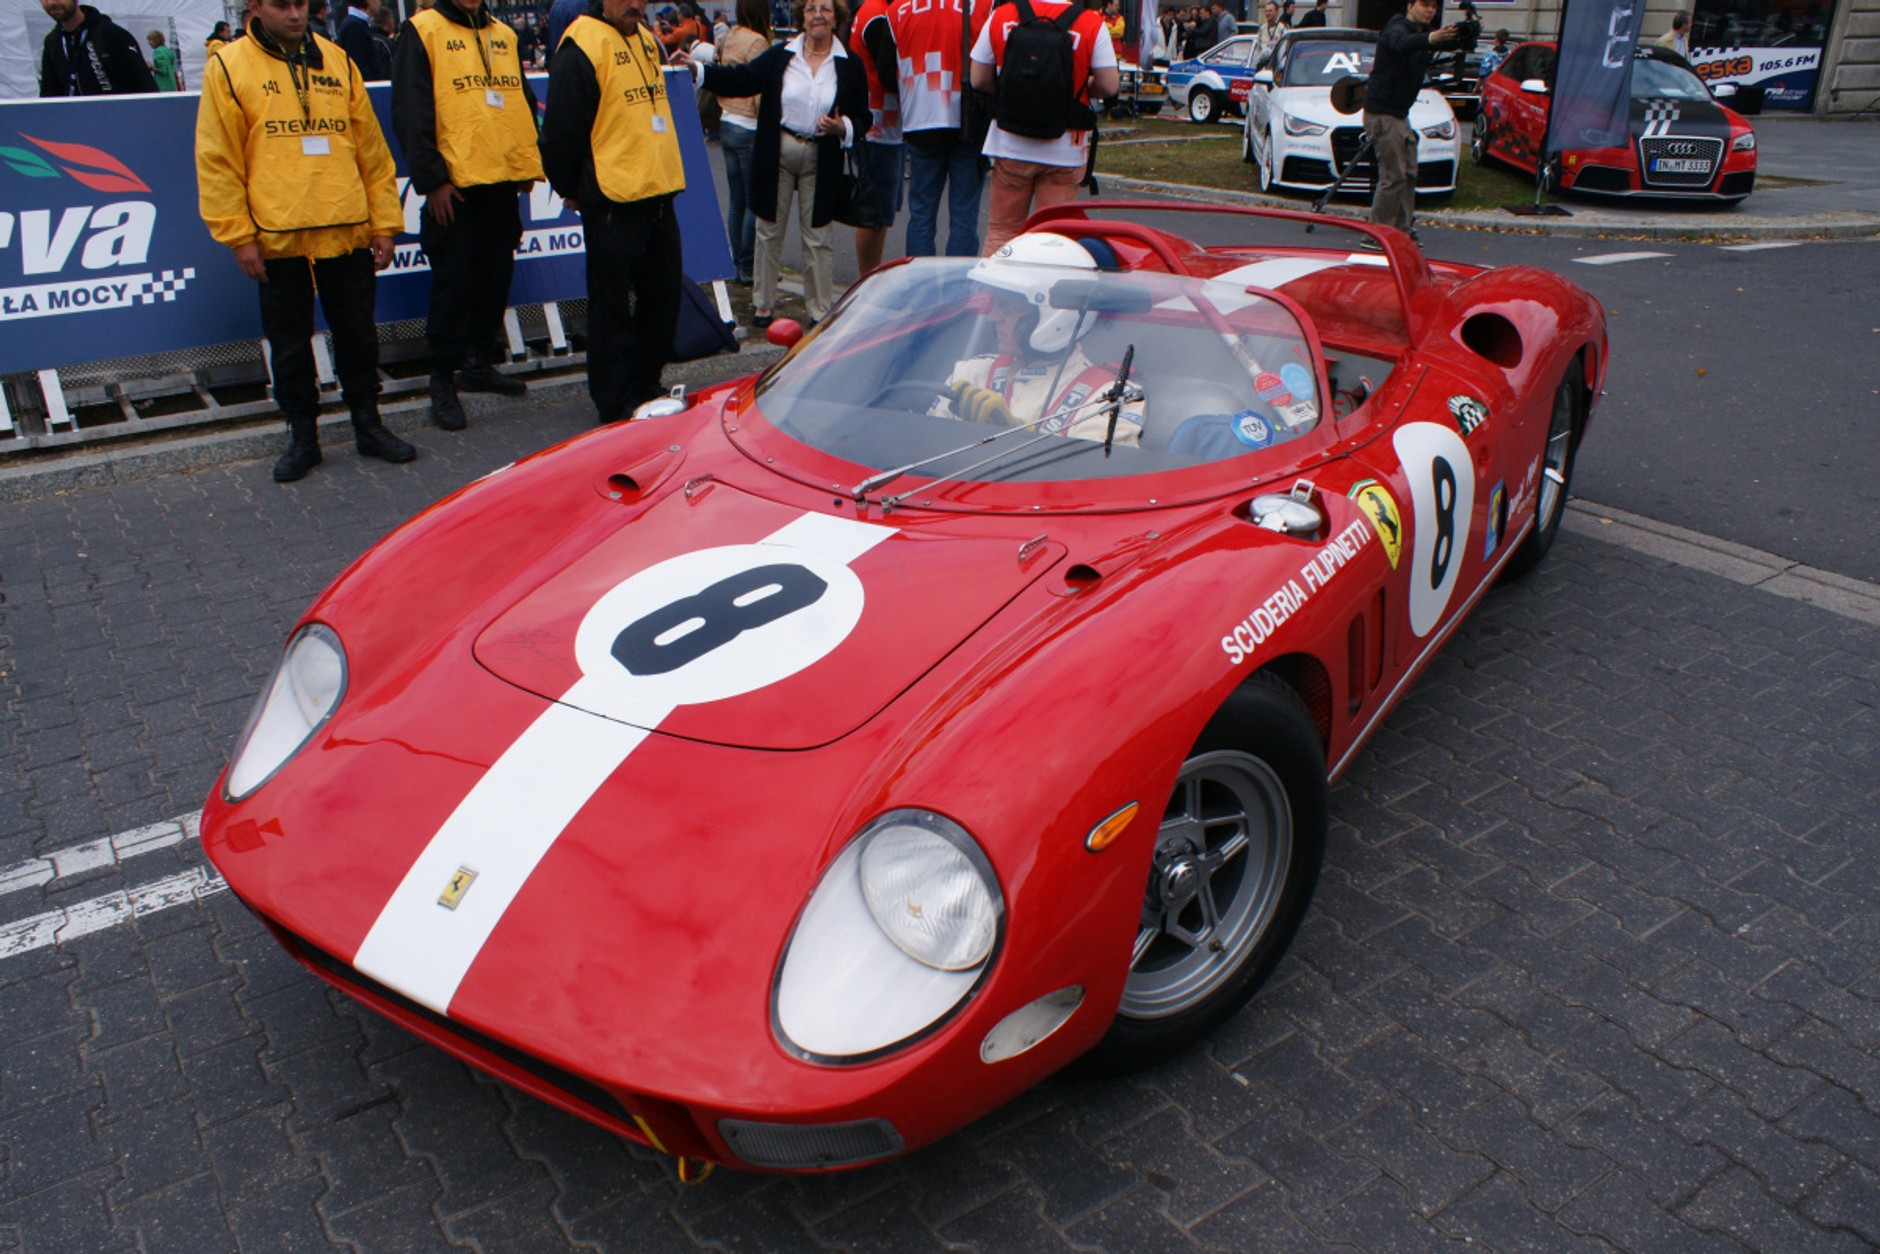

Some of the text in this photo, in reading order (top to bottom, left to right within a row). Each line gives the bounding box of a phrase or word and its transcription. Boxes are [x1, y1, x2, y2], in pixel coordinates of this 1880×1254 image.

[1759, 54, 1816, 72] 105.6 FM
[453, 75, 520, 91] STEWARD
[264, 118, 346, 134] STEWARD
[47, 283, 128, 309] MOCY
[1431, 455, 1457, 590] 8
[1221, 518, 1371, 665] SCUDERIA FILIPINETTI
[610, 563, 829, 677] 8
